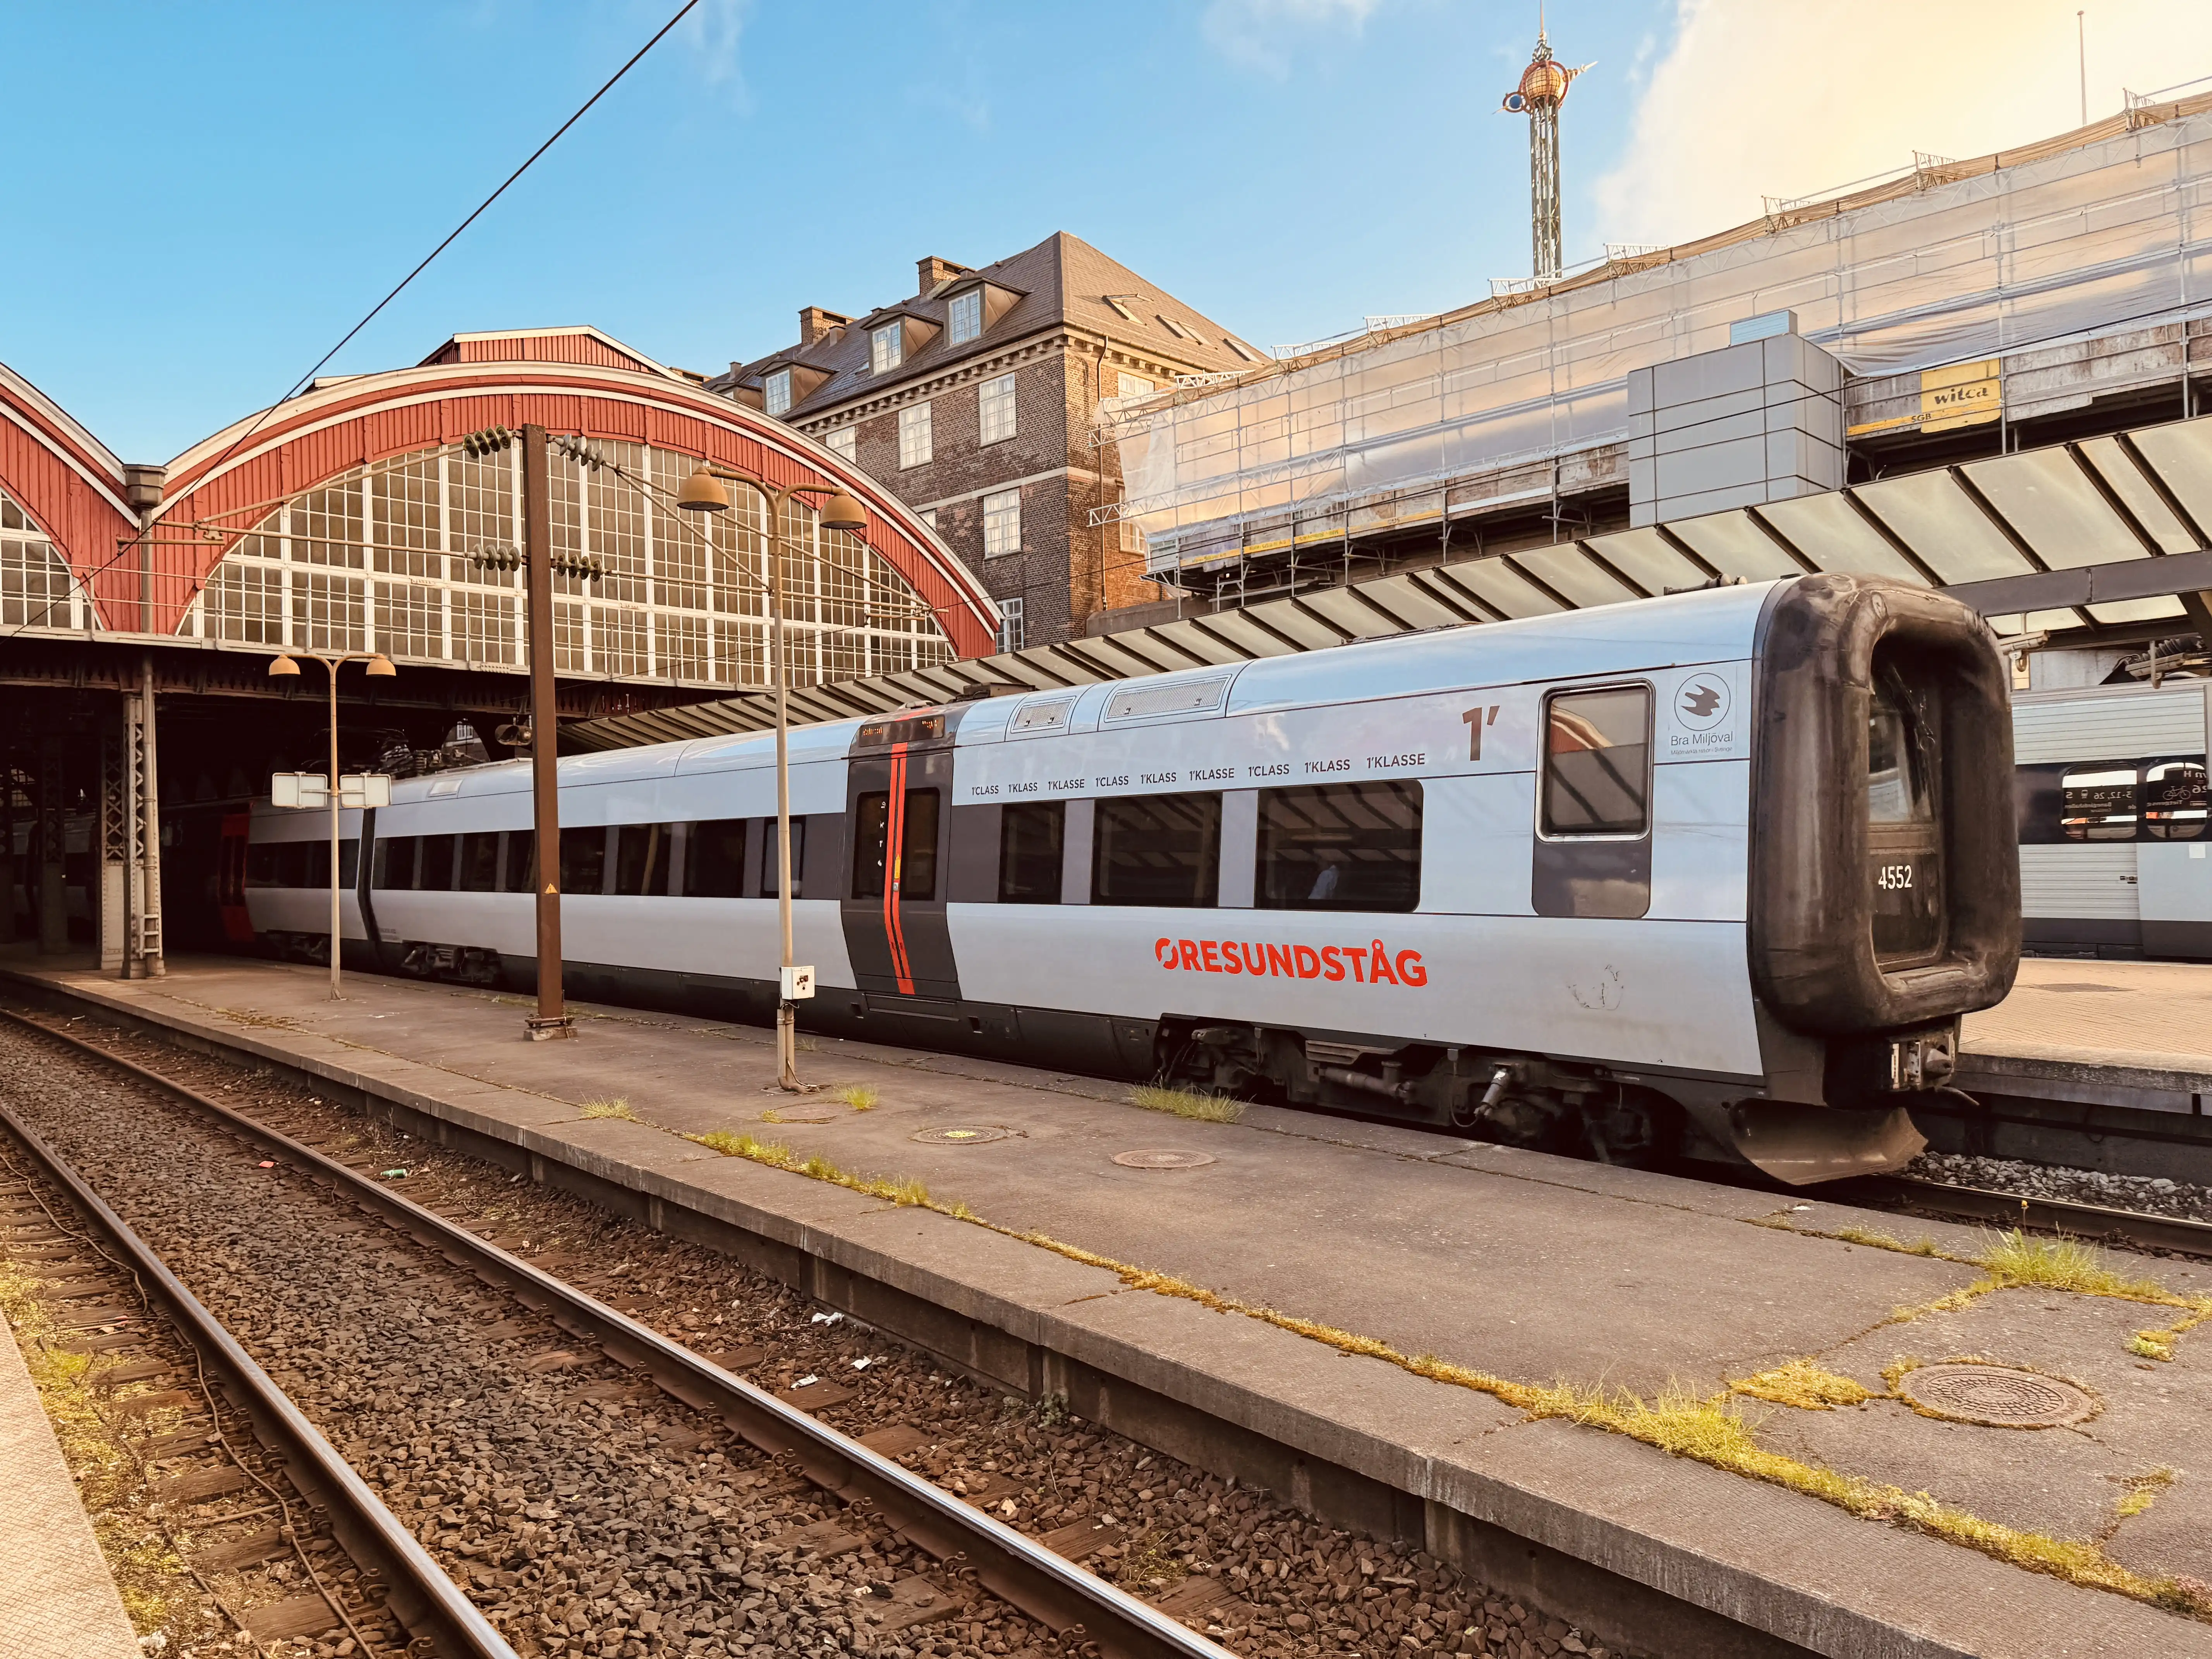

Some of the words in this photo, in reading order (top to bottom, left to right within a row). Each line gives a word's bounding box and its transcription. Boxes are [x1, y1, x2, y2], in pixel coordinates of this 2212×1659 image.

[1934, 386, 1989, 404] witca
[1671, 736, 1689, 746] Bra
[1692, 730, 1733, 746] Miljöval
[1878, 865, 1912, 890] 4552
[1155, 938, 1428, 987] ØRESUNDSTÅG
